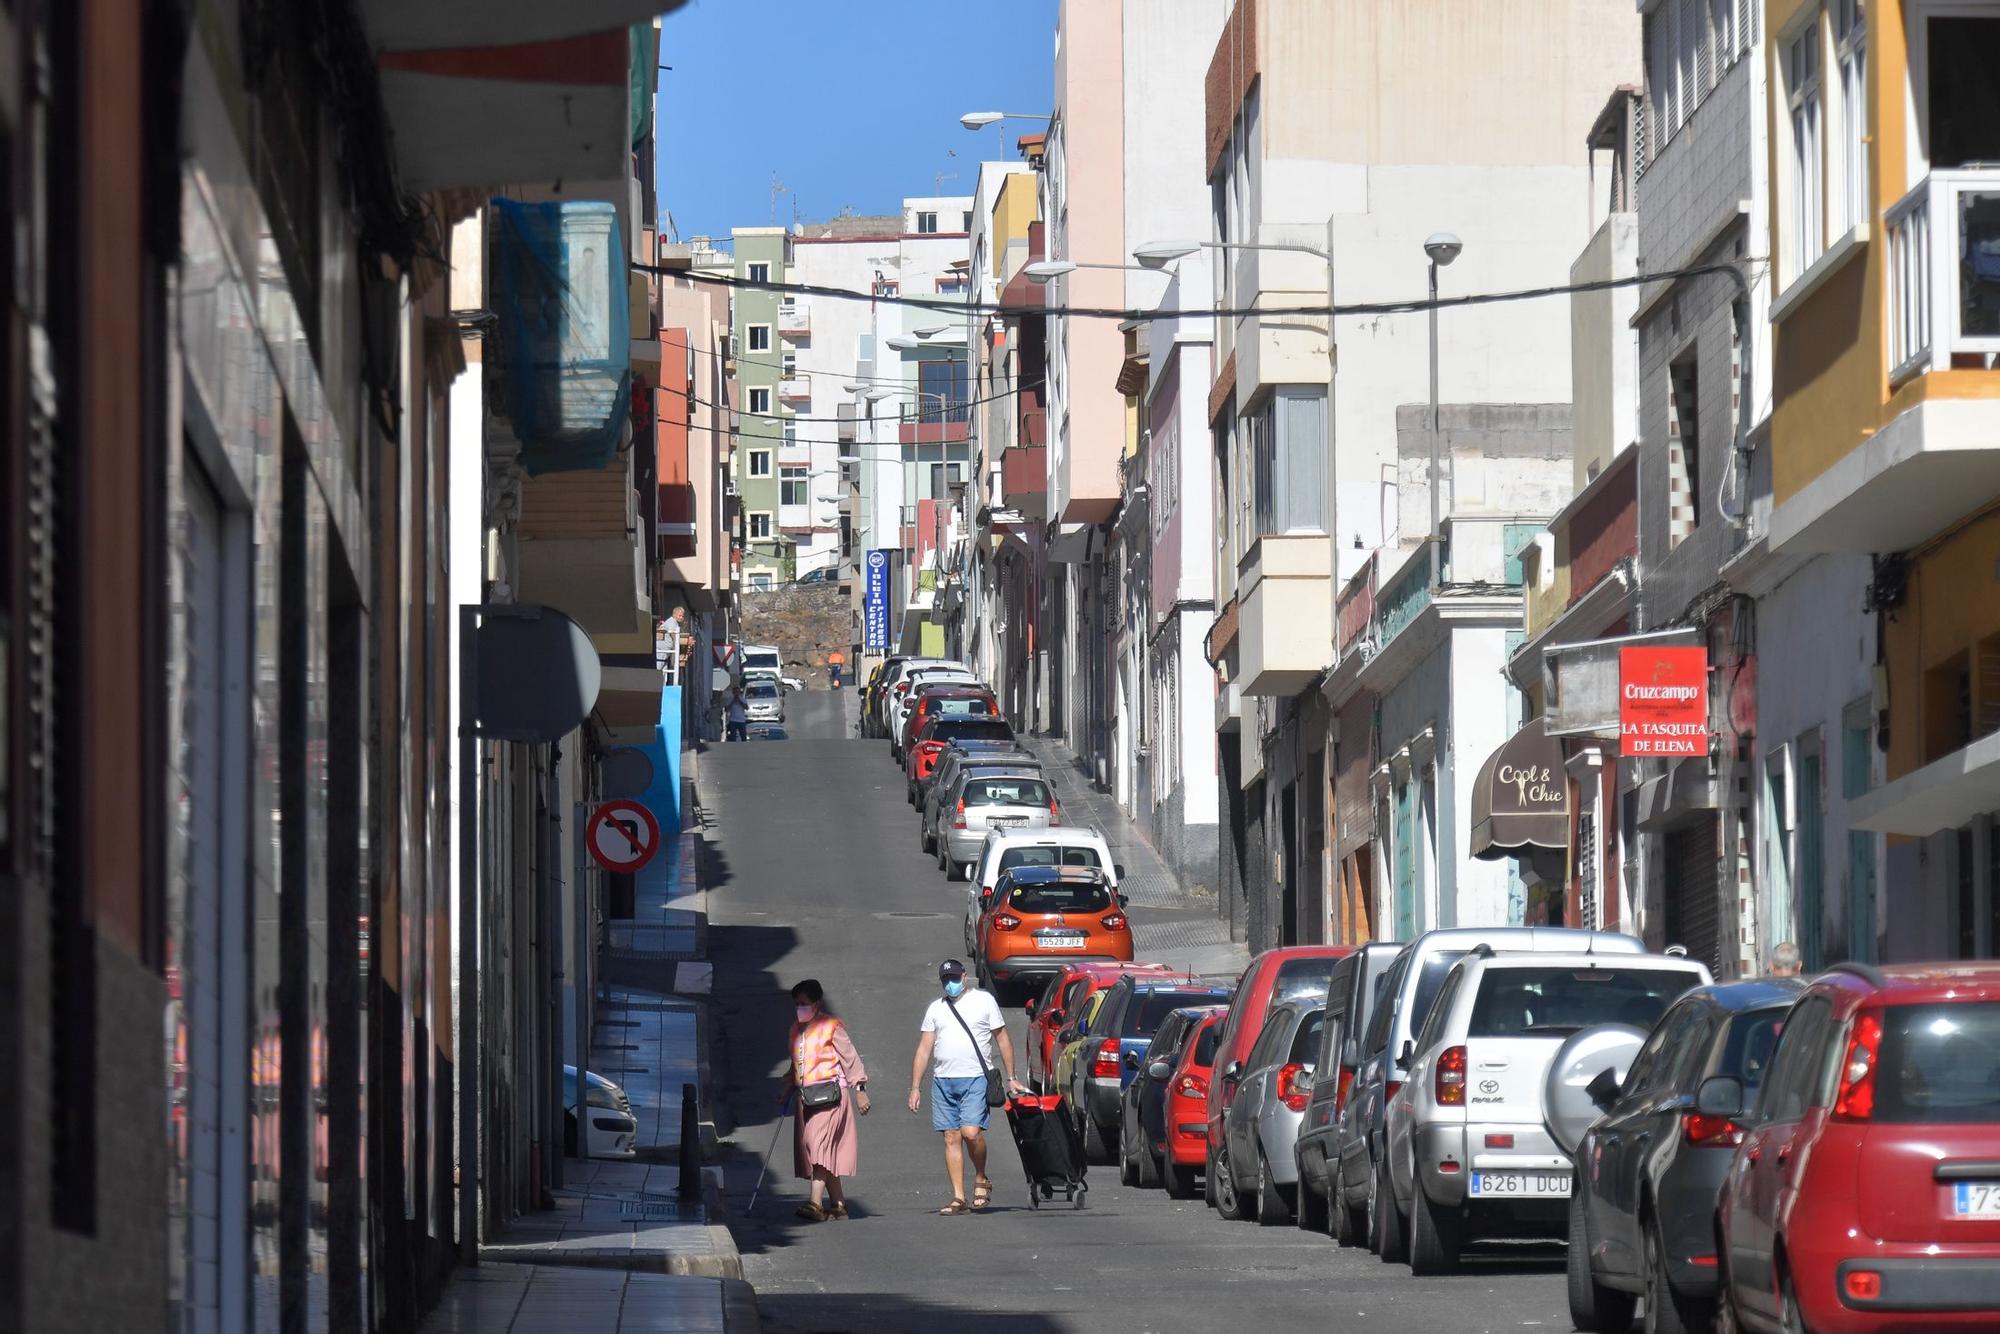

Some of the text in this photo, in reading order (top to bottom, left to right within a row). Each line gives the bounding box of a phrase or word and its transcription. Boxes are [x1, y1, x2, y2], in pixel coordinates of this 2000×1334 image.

[869, 606, 877, 646] CENTRO
[877, 606, 885, 646] FITNESS
[1625, 684, 1698, 702] Cruzcampo
[1622, 723, 1707, 736] LA TASQUITA
[1634, 740, 1695, 752] DE ELENA
[1499, 765, 1551, 784] Cool &
[1529, 783, 1563, 802] Chic
[1044, 937, 1065, 946] 5529
[1482, 1175, 1569, 1192] 6261 DCD
